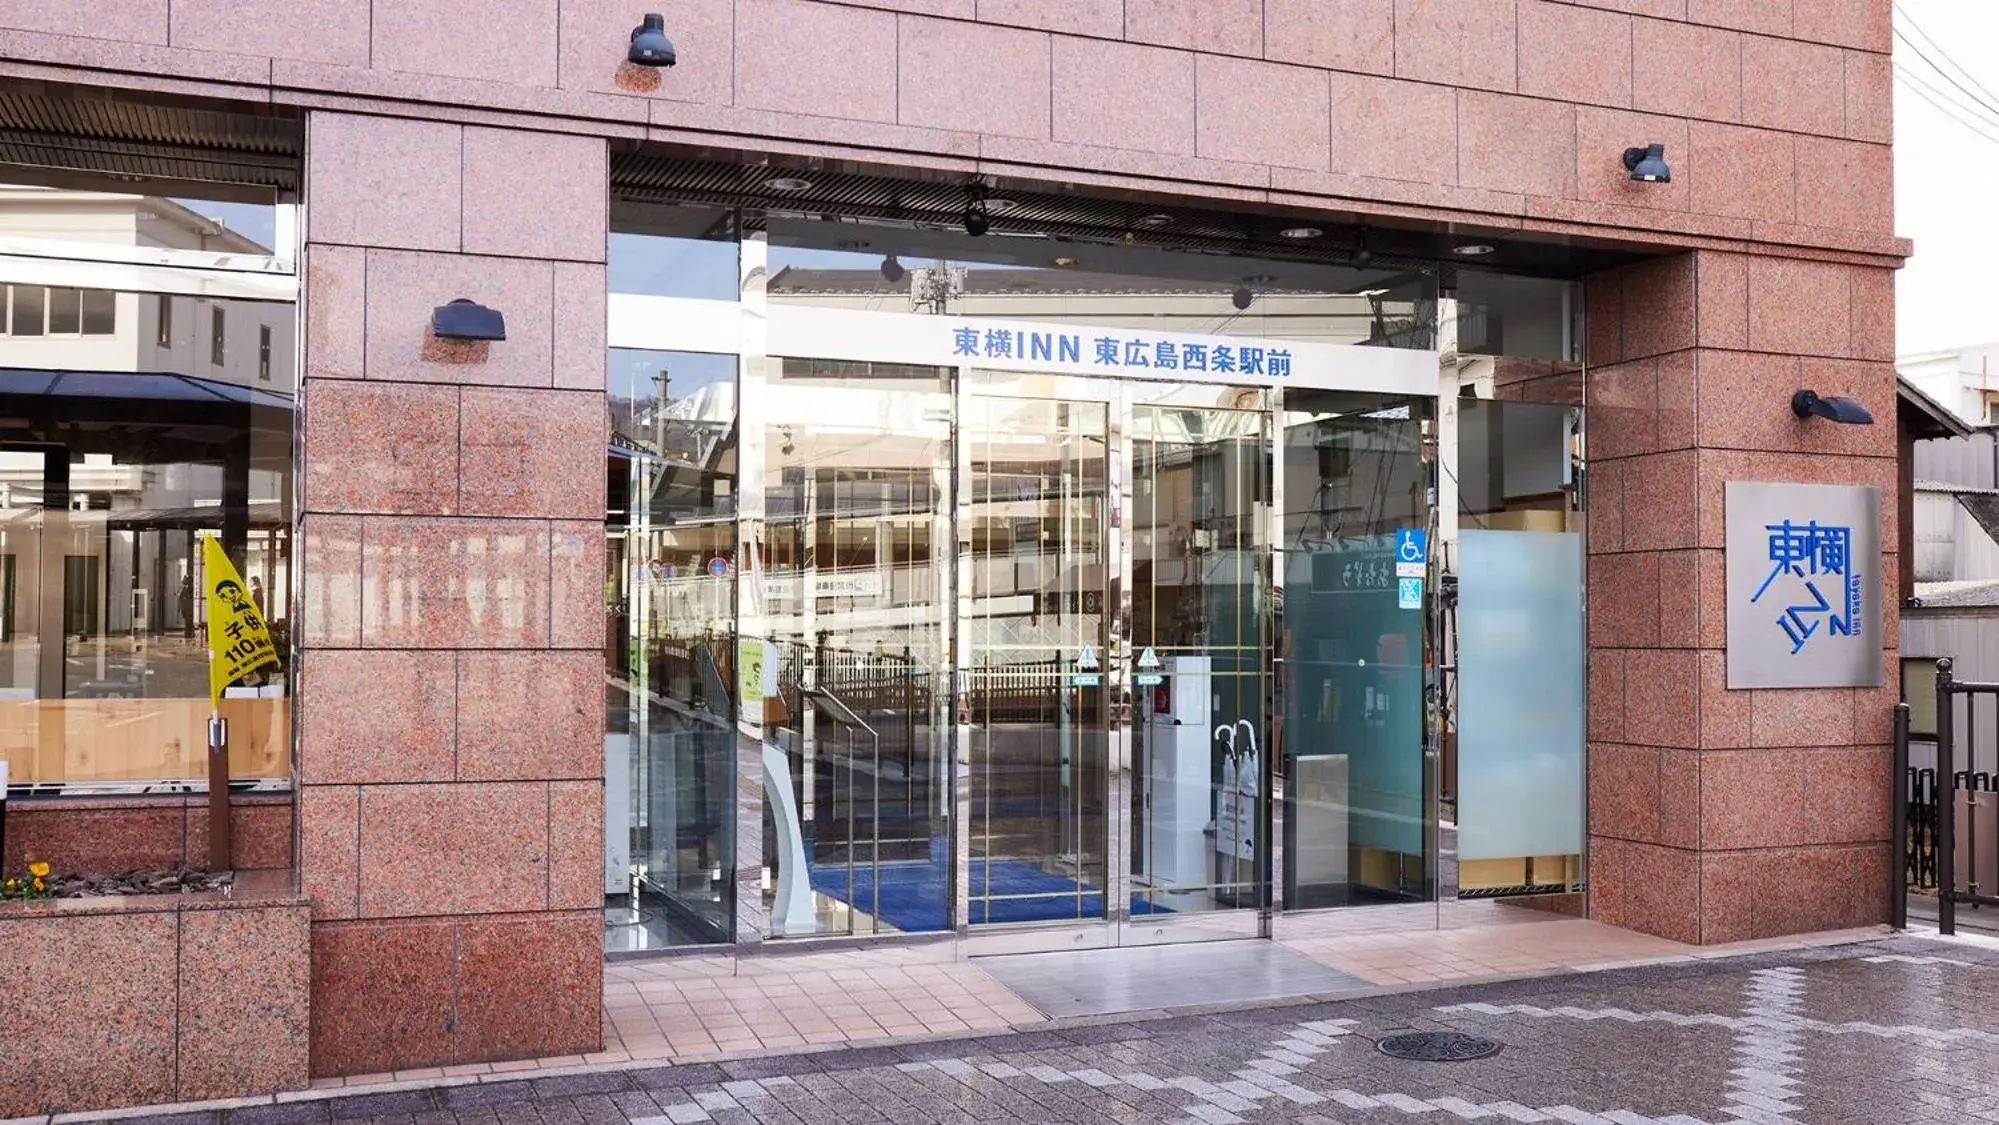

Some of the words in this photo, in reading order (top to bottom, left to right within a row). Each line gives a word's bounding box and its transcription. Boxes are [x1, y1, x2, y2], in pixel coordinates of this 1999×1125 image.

[952, 326, 1081, 363] 東横INN
[1093, 336, 1292, 377] 東広島西条駅前
